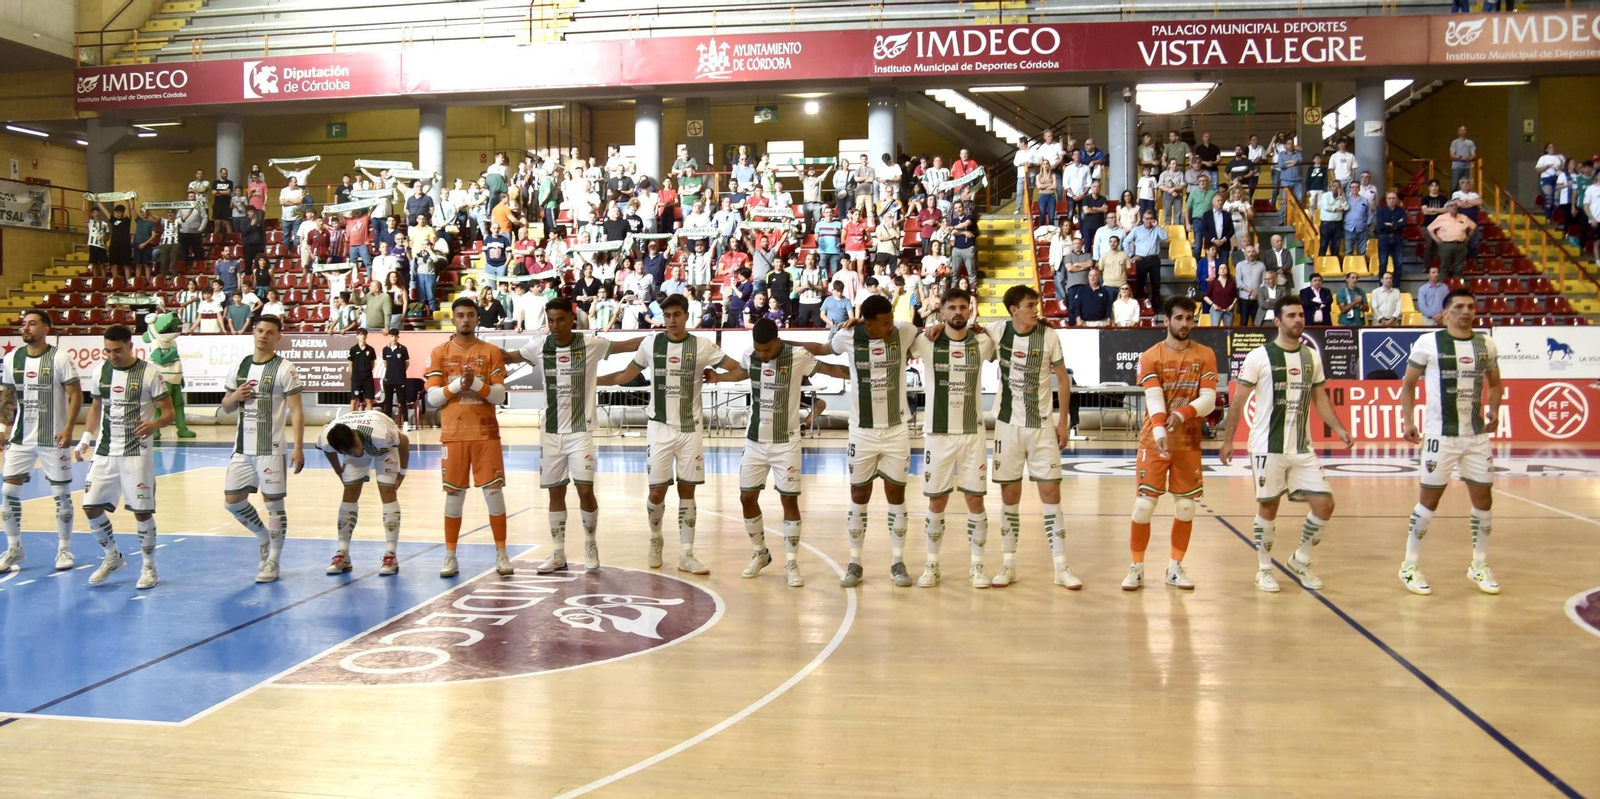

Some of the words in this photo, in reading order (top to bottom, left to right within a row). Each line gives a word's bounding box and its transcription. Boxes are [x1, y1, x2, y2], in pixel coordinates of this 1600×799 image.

[1151, 24, 1207, 36] PALACIO
[1210, 23, 1280, 35] MUNICIPAL
[1284, 21, 1348, 34] DEPORTES
[733, 42, 802, 56] AYUNTAMIENTO
[916, 27, 1061, 58] IMDECO
[1137, 39, 1228, 67] VISTA
[1238, 36, 1367, 64] ALEGRE
[1446, 52, 1486, 61] Instituto
[1488, 50, 1537, 60] Municipal
[1539, 49, 1552, 58] de
[733, 59, 745, 71] DE
[746, 56, 792, 71] CÓRDOBA
[874, 65, 911, 74] Instituto
[914, 63, 959, 73] Municipal
[961, 62, 973, 71] de
[975, 62, 1018, 72] Deportes
[1019, 60, 1060, 69] Córdoba
[283, 65, 350, 81] Diputación
[102, 69, 188, 92] IMDECO
[283, 82, 298, 93] de
[301, 80, 350, 92] Córdoba
[100, 94, 127, 102] Municipal
[136, 92, 162, 100] Deportes
[163, 91, 187, 99] Córdoba
[1237, 99, 1248, 112] H
[761, 107, 772, 121] G
[332, 125, 341, 136] F
[291, 338, 328, 348] TABERNA
[273, 348, 301, 359] ARTÉN
[302, 350, 314, 359] DE
[315, 350, 326, 359] LA
[327, 350, 351, 359] ABUE
[994, 440, 1002, 454] 11
[1427, 438, 1439, 453] 10
[926, 450, 931, 465] 6
[1141, 448, 1147, 463] 1
[1255, 455, 1267, 470] 17
[339, 568, 588, 674] IMDECO
